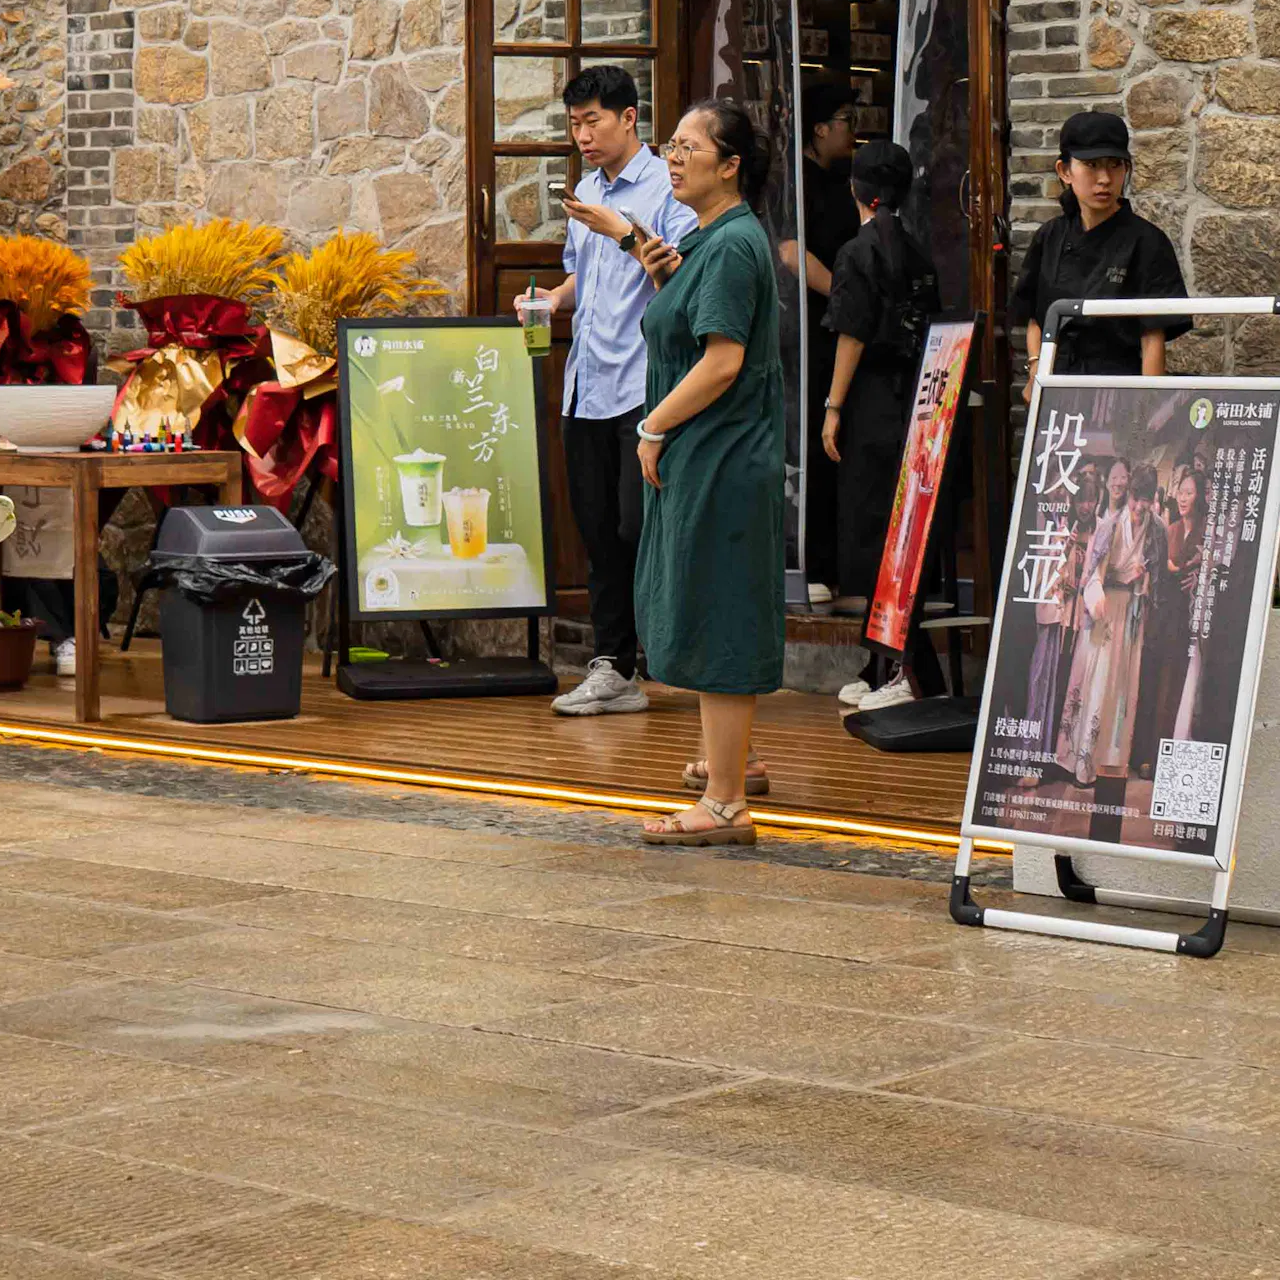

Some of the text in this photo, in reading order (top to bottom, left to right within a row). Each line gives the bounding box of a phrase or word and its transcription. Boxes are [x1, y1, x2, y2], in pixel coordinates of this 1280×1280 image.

[1216, 402, 1273, 419] 荷田水铺
[1032, 409, 1088, 495] 投
[1241, 447, 1267, 542] 活动奖励
[1037, 502, 1070, 514] TOU HU
[994, 716, 1041, 740] 投壶规则
